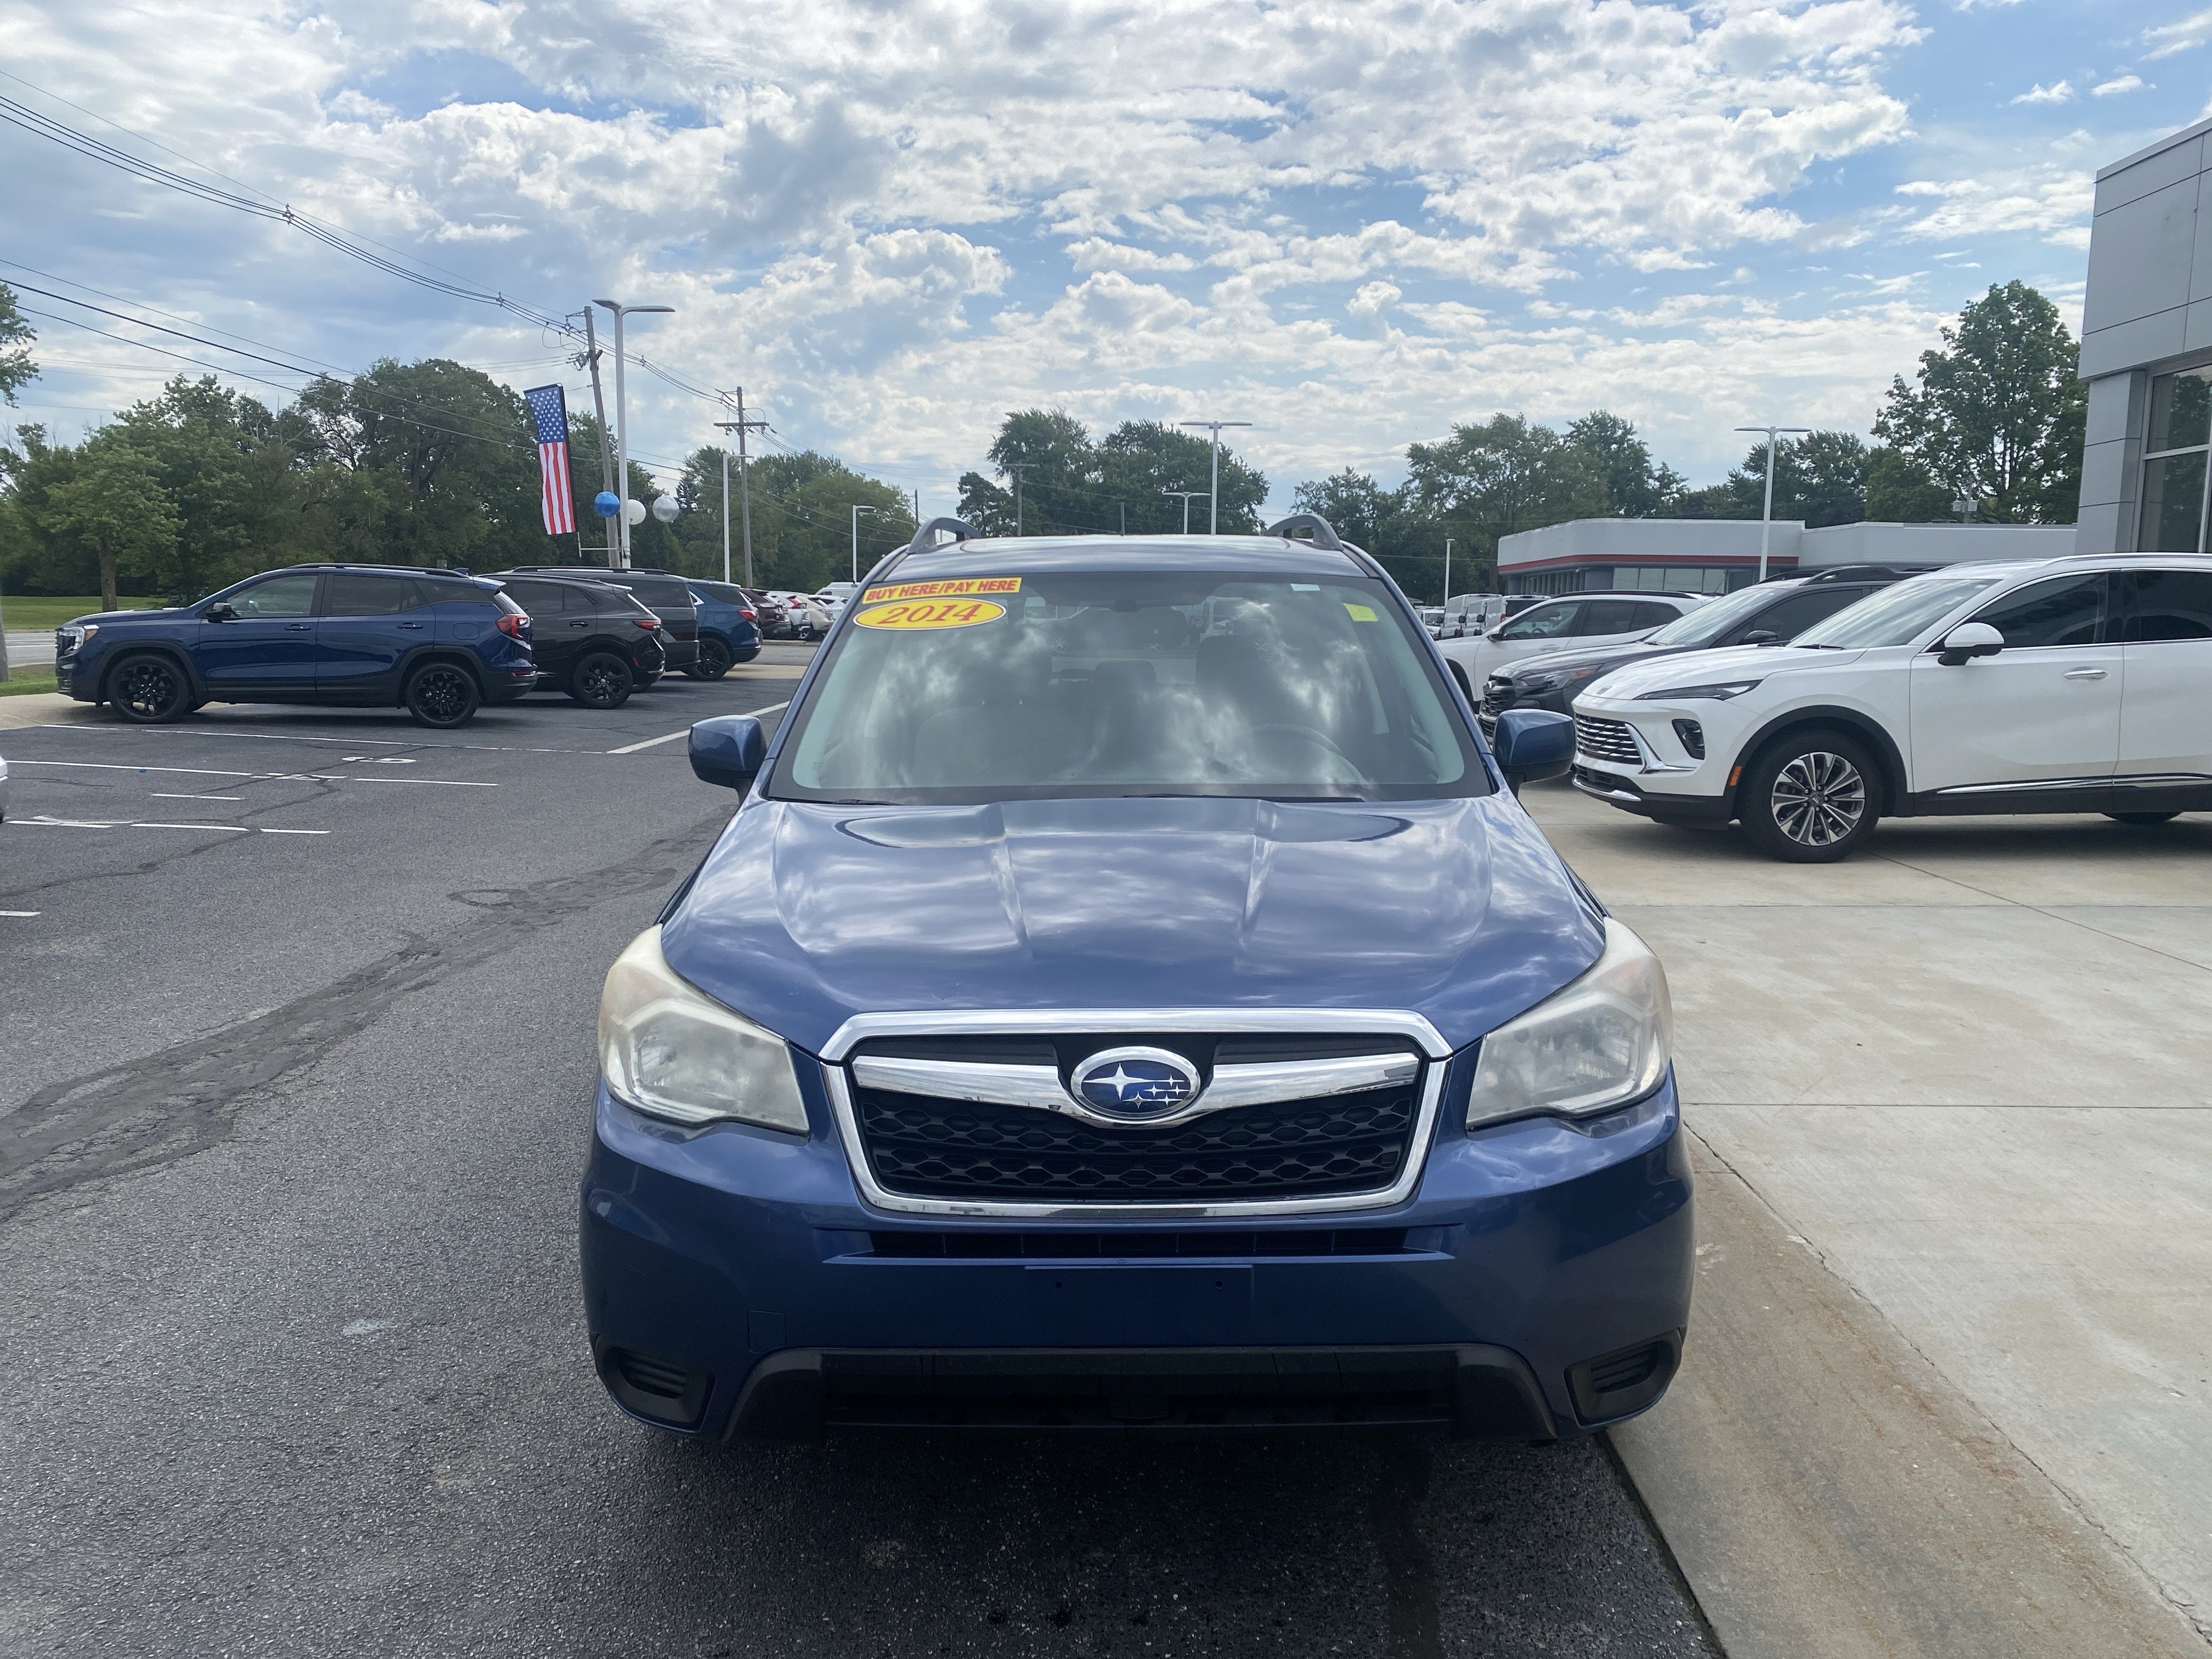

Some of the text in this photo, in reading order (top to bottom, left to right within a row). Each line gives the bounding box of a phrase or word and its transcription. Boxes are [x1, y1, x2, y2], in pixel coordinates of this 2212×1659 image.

[865, 580, 1019, 601] BUY HERE/PAY HERE
[876, 603, 982, 624] 2014
